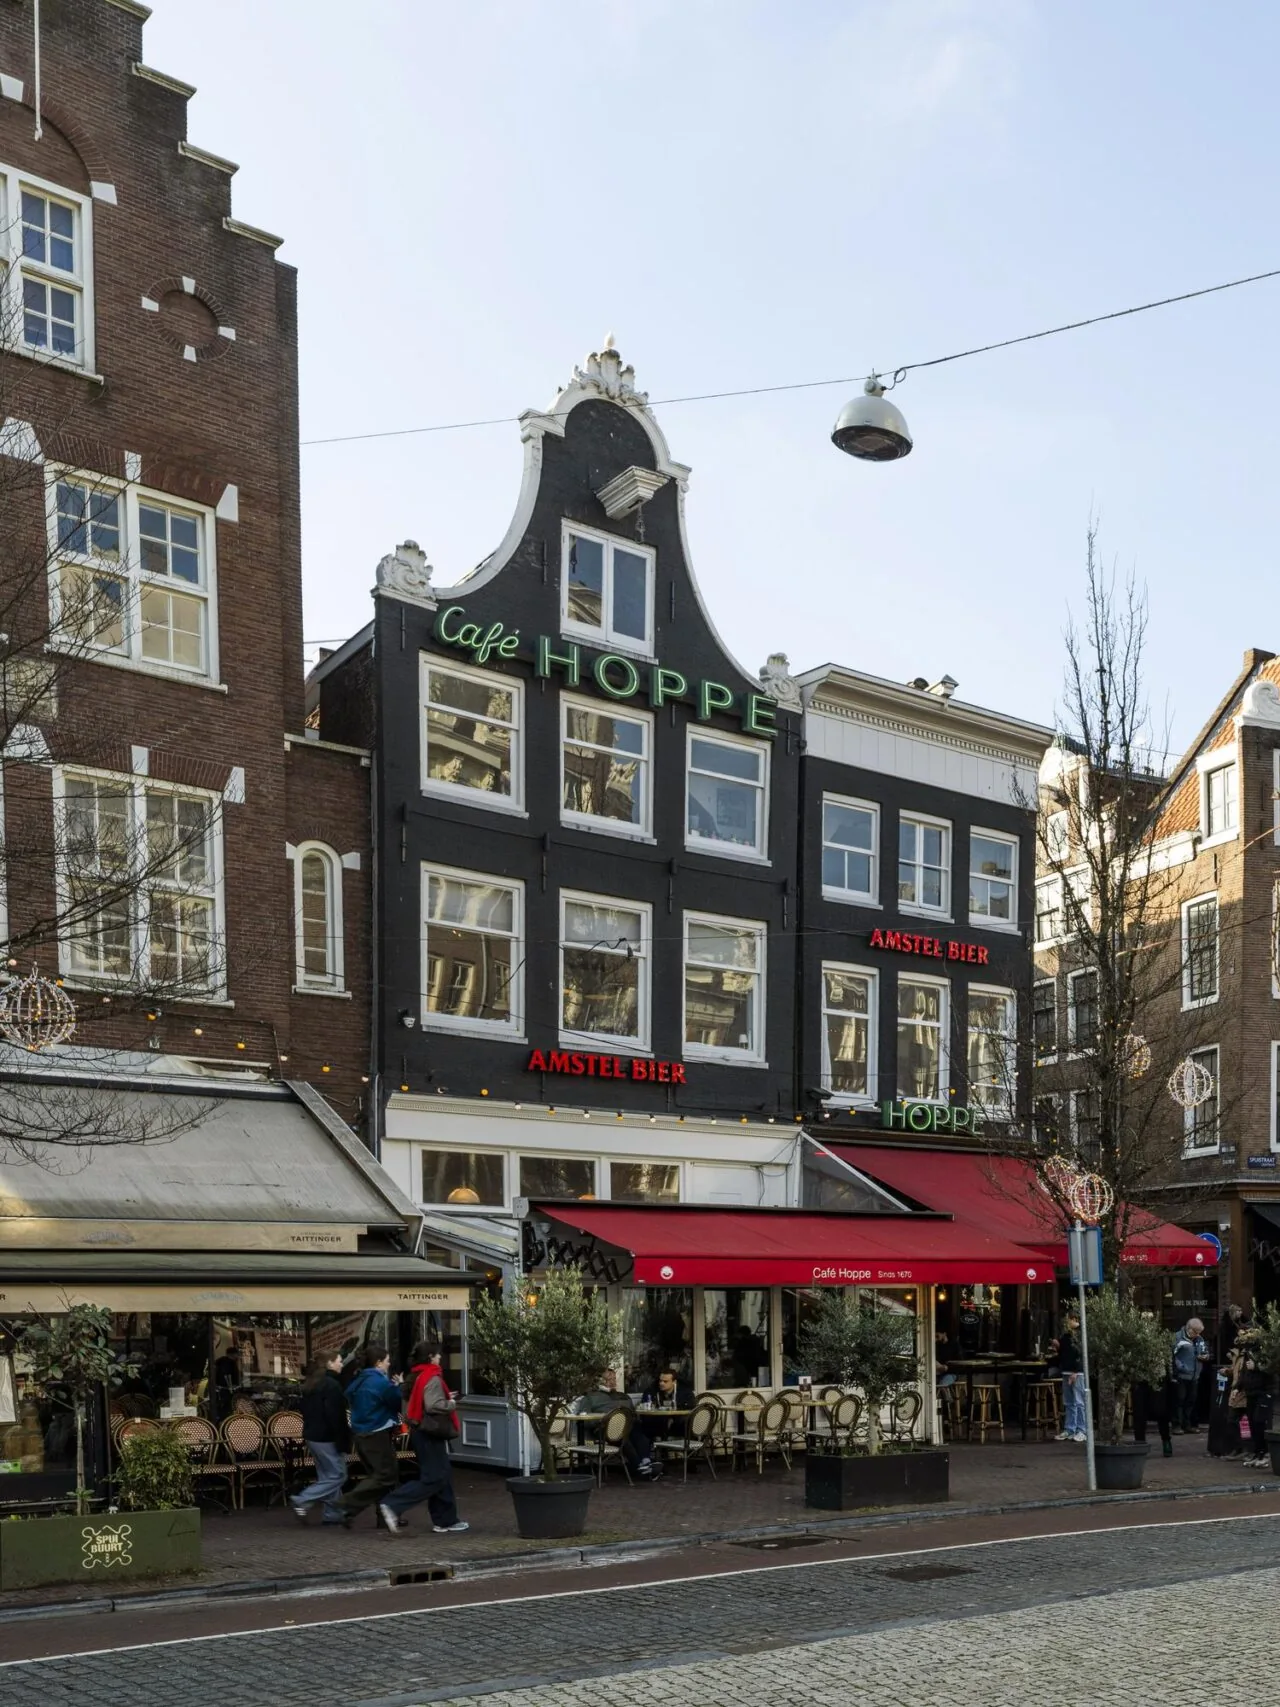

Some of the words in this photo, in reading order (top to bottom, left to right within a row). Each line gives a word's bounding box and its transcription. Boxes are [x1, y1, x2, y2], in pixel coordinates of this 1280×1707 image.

[434, 605, 520, 664] Café
[535, 634, 779, 736] HOPPE
[870, 928, 943, 958] AMSTEL
[948, 940, 989, 965] BIER
[528, 1049, 626, 1079] AMSTEL
[631, 1058, 688, 1085] BIER
[883, 1100, 986, 1135] HOPPE
[290, 1235, 343, 1243] TAITTINGER
[812, 1266, 837, 1279] Café
[838, 1267, 872, 1281] Hoppe
[897, 1271, 913, 1279] 1670
[397, 1293, 450, 1301] TAITTINGER
[95, 1534, 119, 1545] SPUI
[90, 1542, 123, 1554] BUURT
